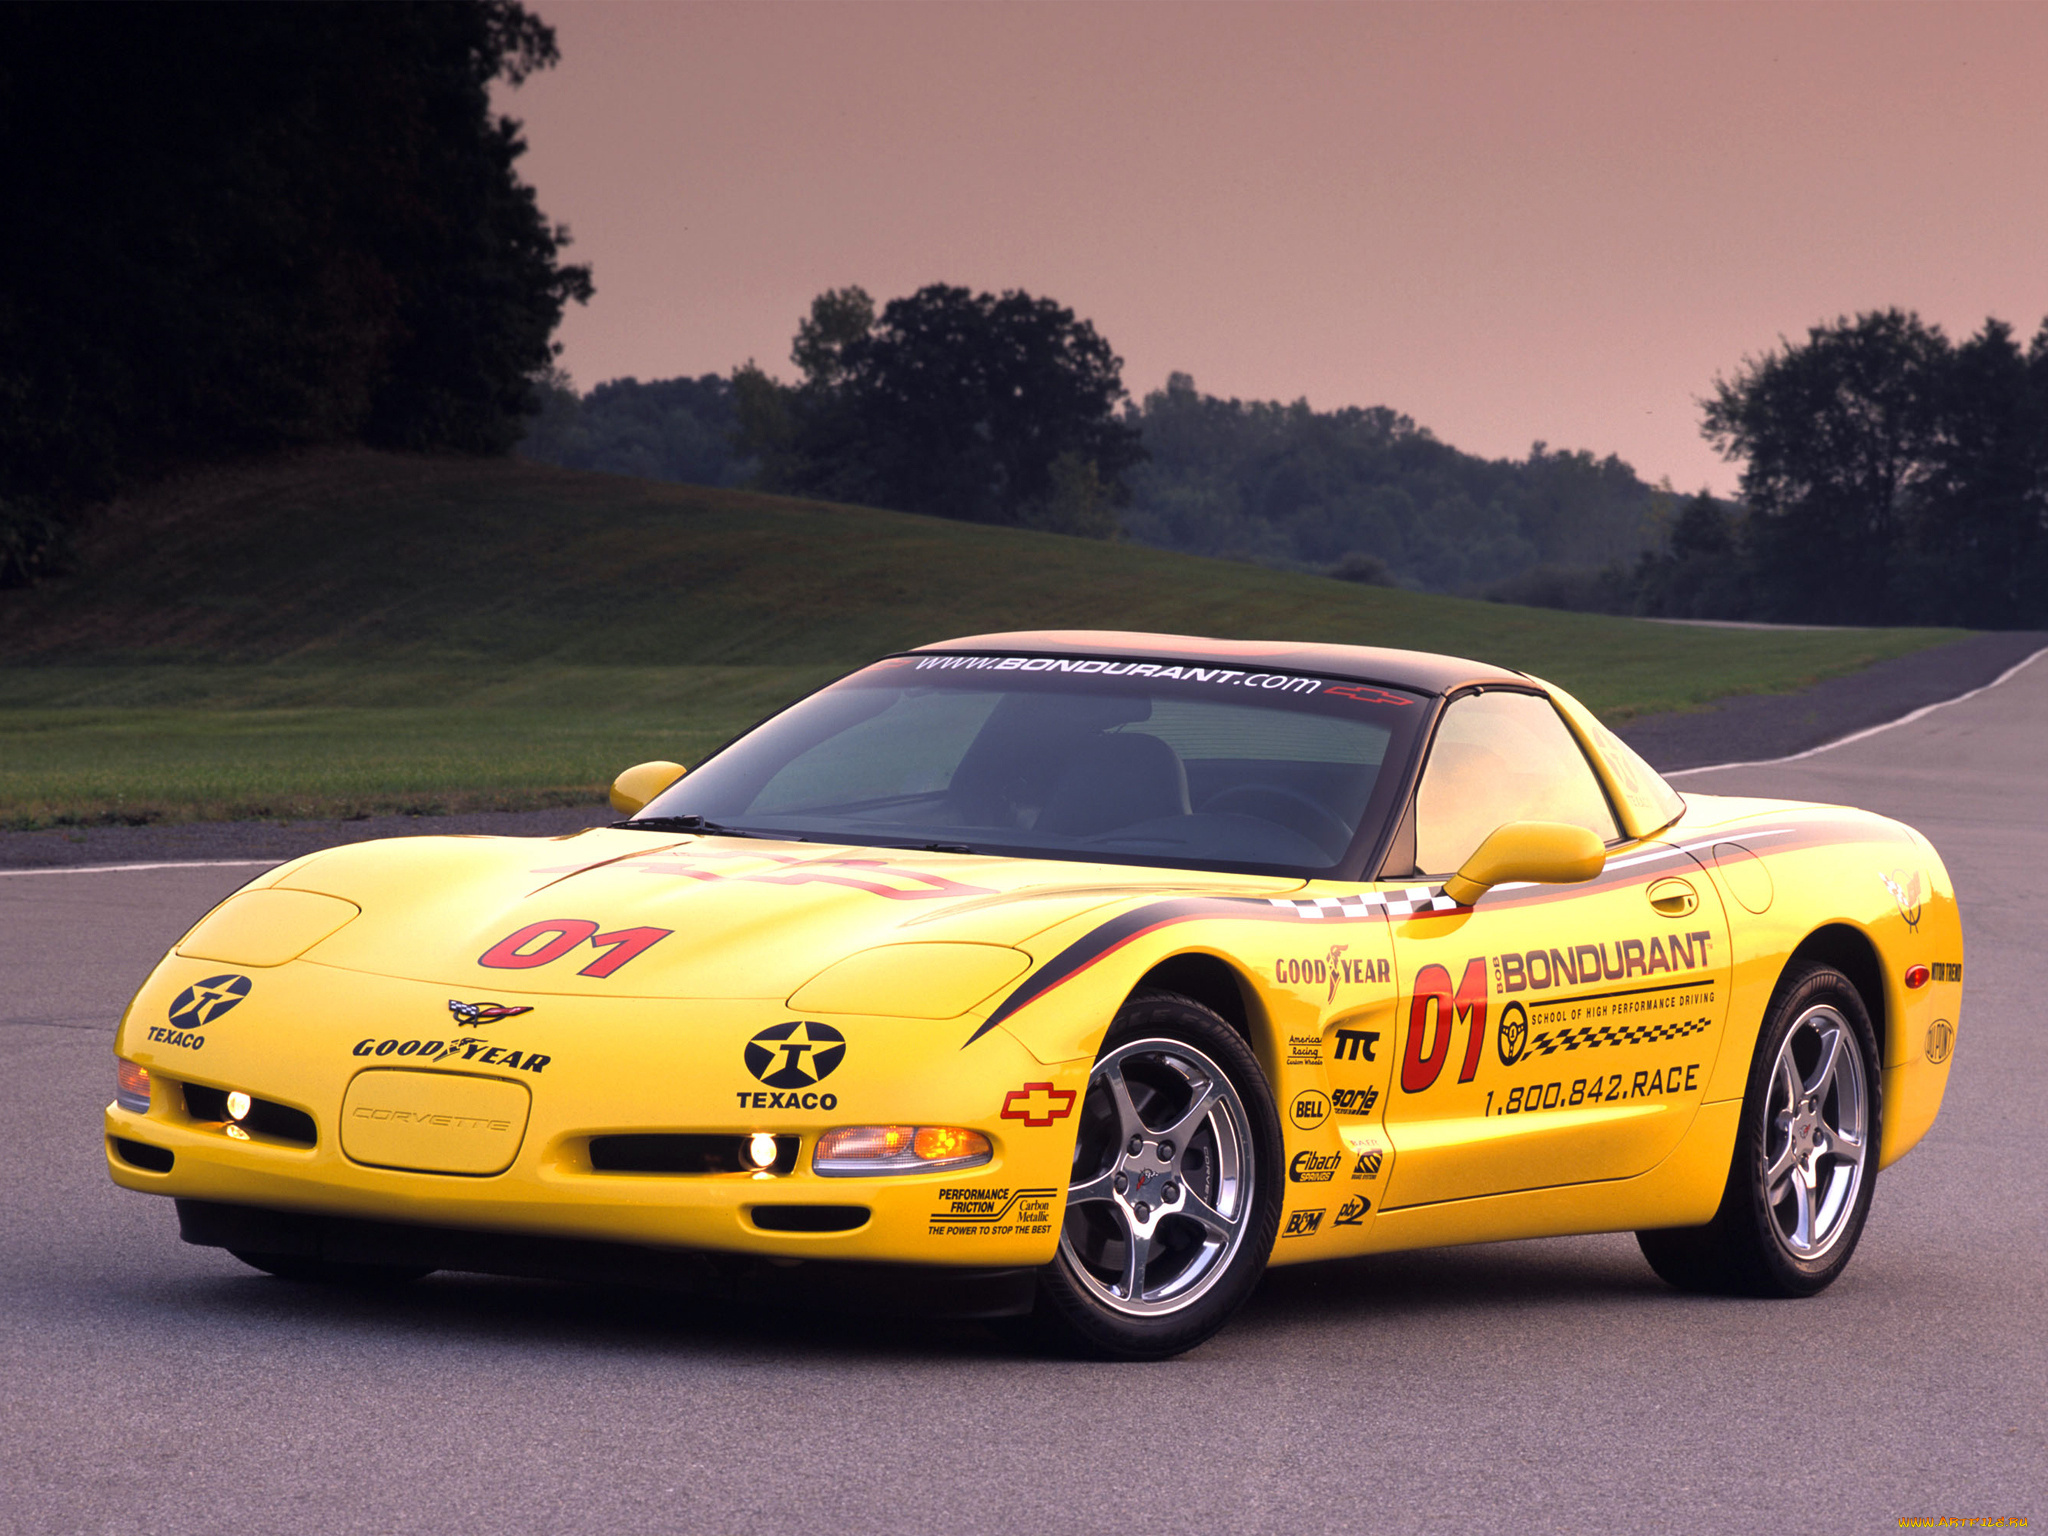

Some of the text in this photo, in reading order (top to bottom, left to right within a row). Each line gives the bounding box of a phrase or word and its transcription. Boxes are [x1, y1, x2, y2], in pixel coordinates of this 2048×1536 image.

[915, 656, 1322, 694] www.BONDURANT.com
[477, 918, 676, 979] 01
[1500, 930, 1712, 993] BONDURANT
[1492, 956, 1504, 994] BOB
[1532, 992, 1715, 1025] SCHOOL OF HIGH PERFORMANCE DRIVING
[1399, 956, 1488, 1094] 01
[147, 1026, 205, 1051] TEXACO
[1293, 1047, 1318, 1059] Racing
[736, 1092, 838, 1111] TEXACO
[1485, 1063, 1700, 1117] 1.800.842.RACE
[352, 1107, 511, 1132] CORVETTE
[1296, 1100, 1323, 1118] BELL
[1203, 1146, 1211, 1203] CORVET
[1289, 1150, 1342, 1183] Eibach
[1300, 1172, 1331, 1182] SPRINGS
[938, 1188, 1010, 1200] PERFORMANCE
[1019, 1199, 1049, 1211] Carbon
[950, 1201, 995, 1213] FRICTION
[1017, 1211, 1049, 1223] Metallic
[928, 1224, 1052, 1235] THE POWER TO STOP THE BEST
